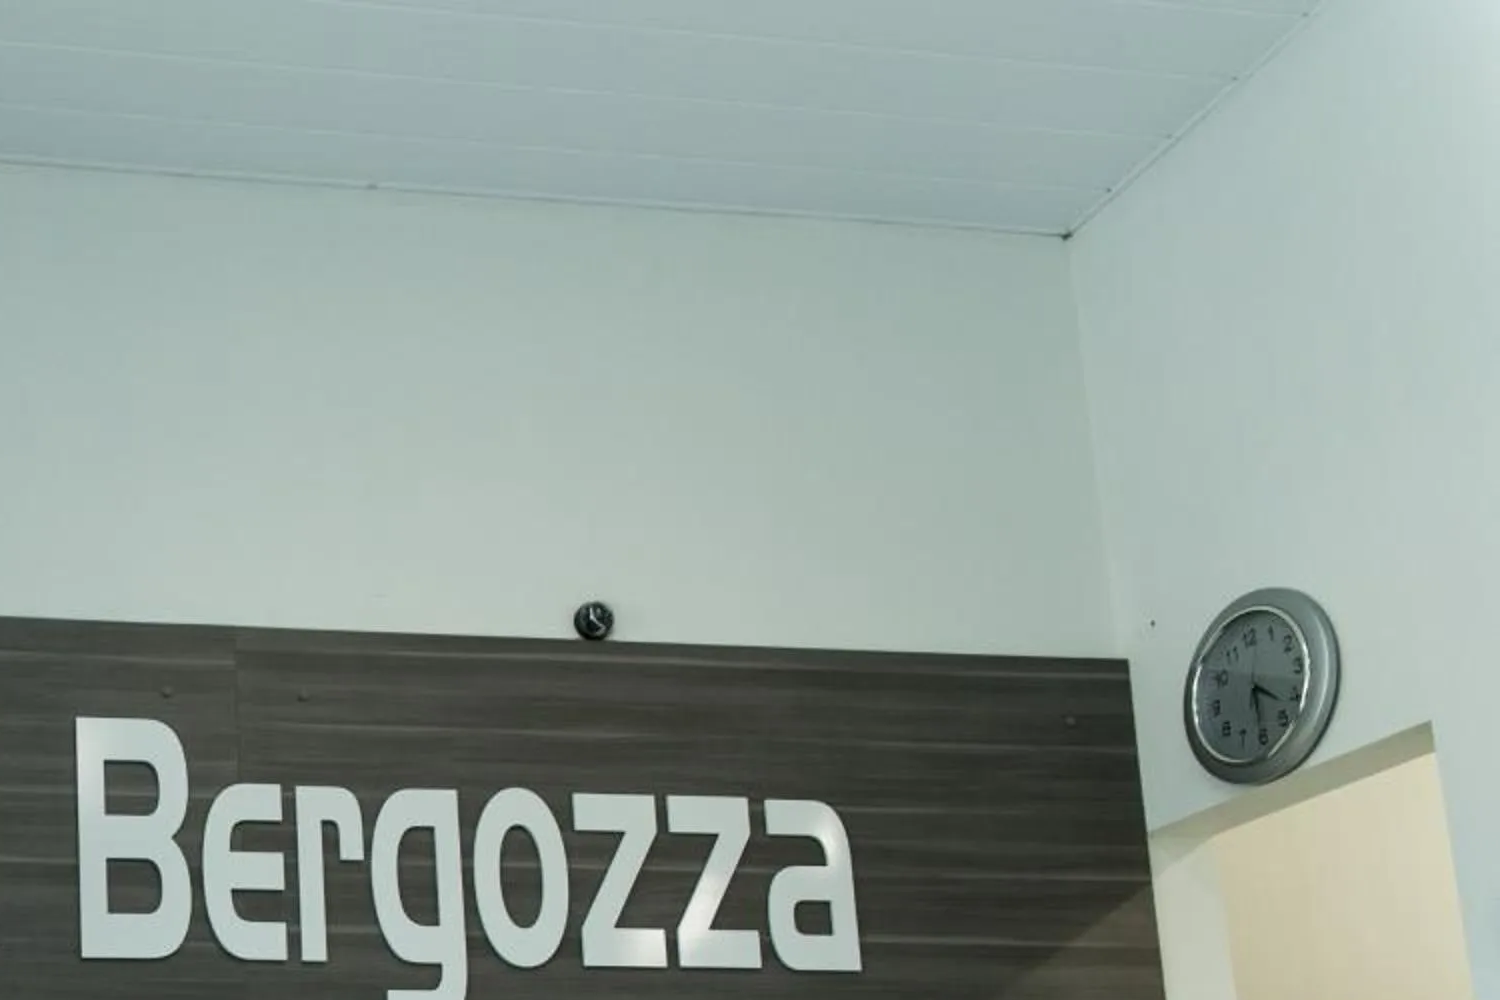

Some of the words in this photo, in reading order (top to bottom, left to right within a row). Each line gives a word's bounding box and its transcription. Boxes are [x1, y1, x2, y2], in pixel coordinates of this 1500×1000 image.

[1242, 626, 1258, 648] 12
[1283, 633, 1294, 654] 2
[1221, 720, 1232, 738] 8
[1258, 727, 1270, 747] 6
